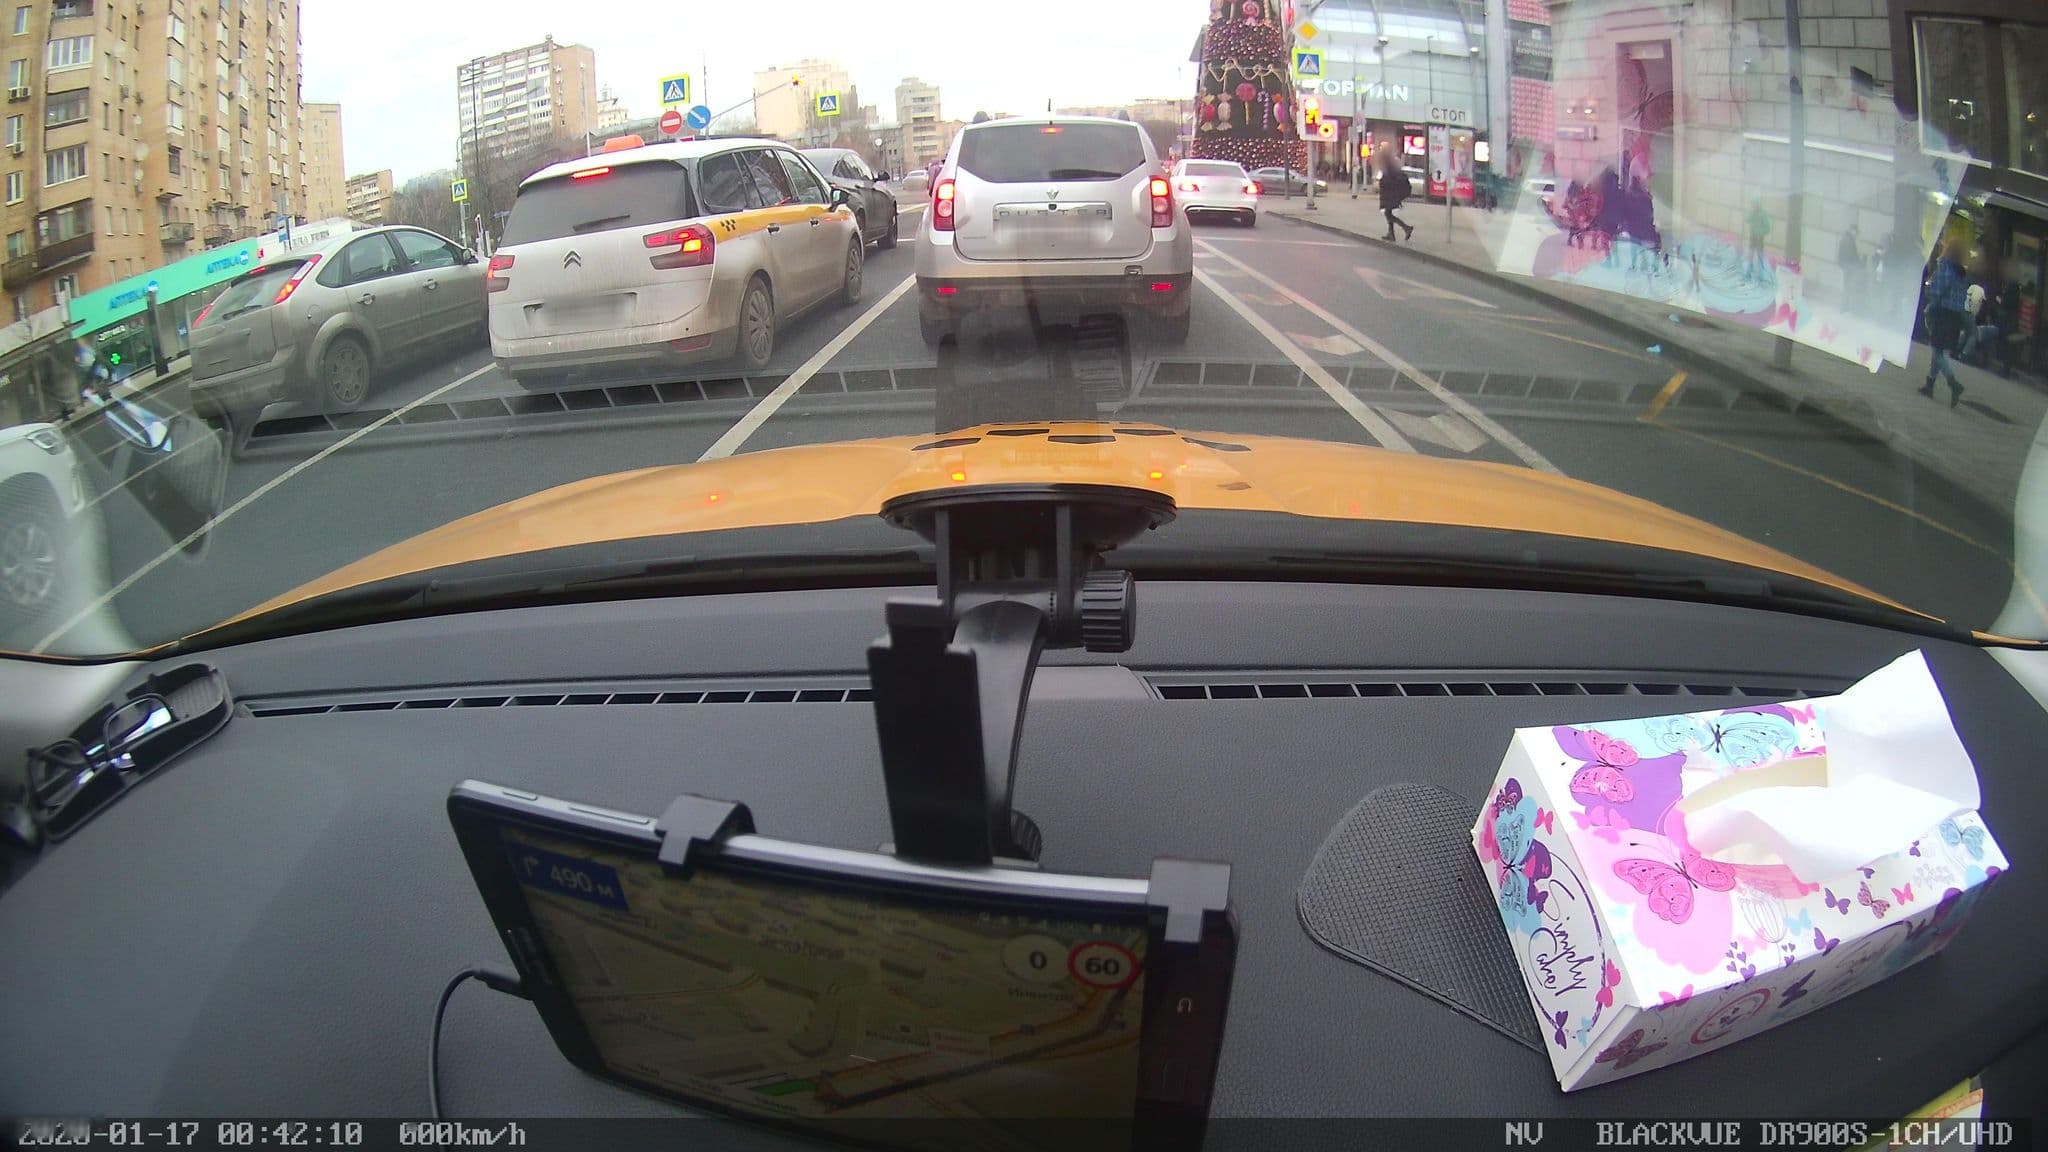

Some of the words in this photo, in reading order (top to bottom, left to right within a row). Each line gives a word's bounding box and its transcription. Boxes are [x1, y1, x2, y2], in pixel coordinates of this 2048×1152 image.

[1431, 107, 1466, 122] СТОП
[551, 864, 592, 893] 490
[1543, 879, 1595, 996] Simply
[1029, 951, 1047, 970] 0
[1085, 957, 1120, 976] 60
